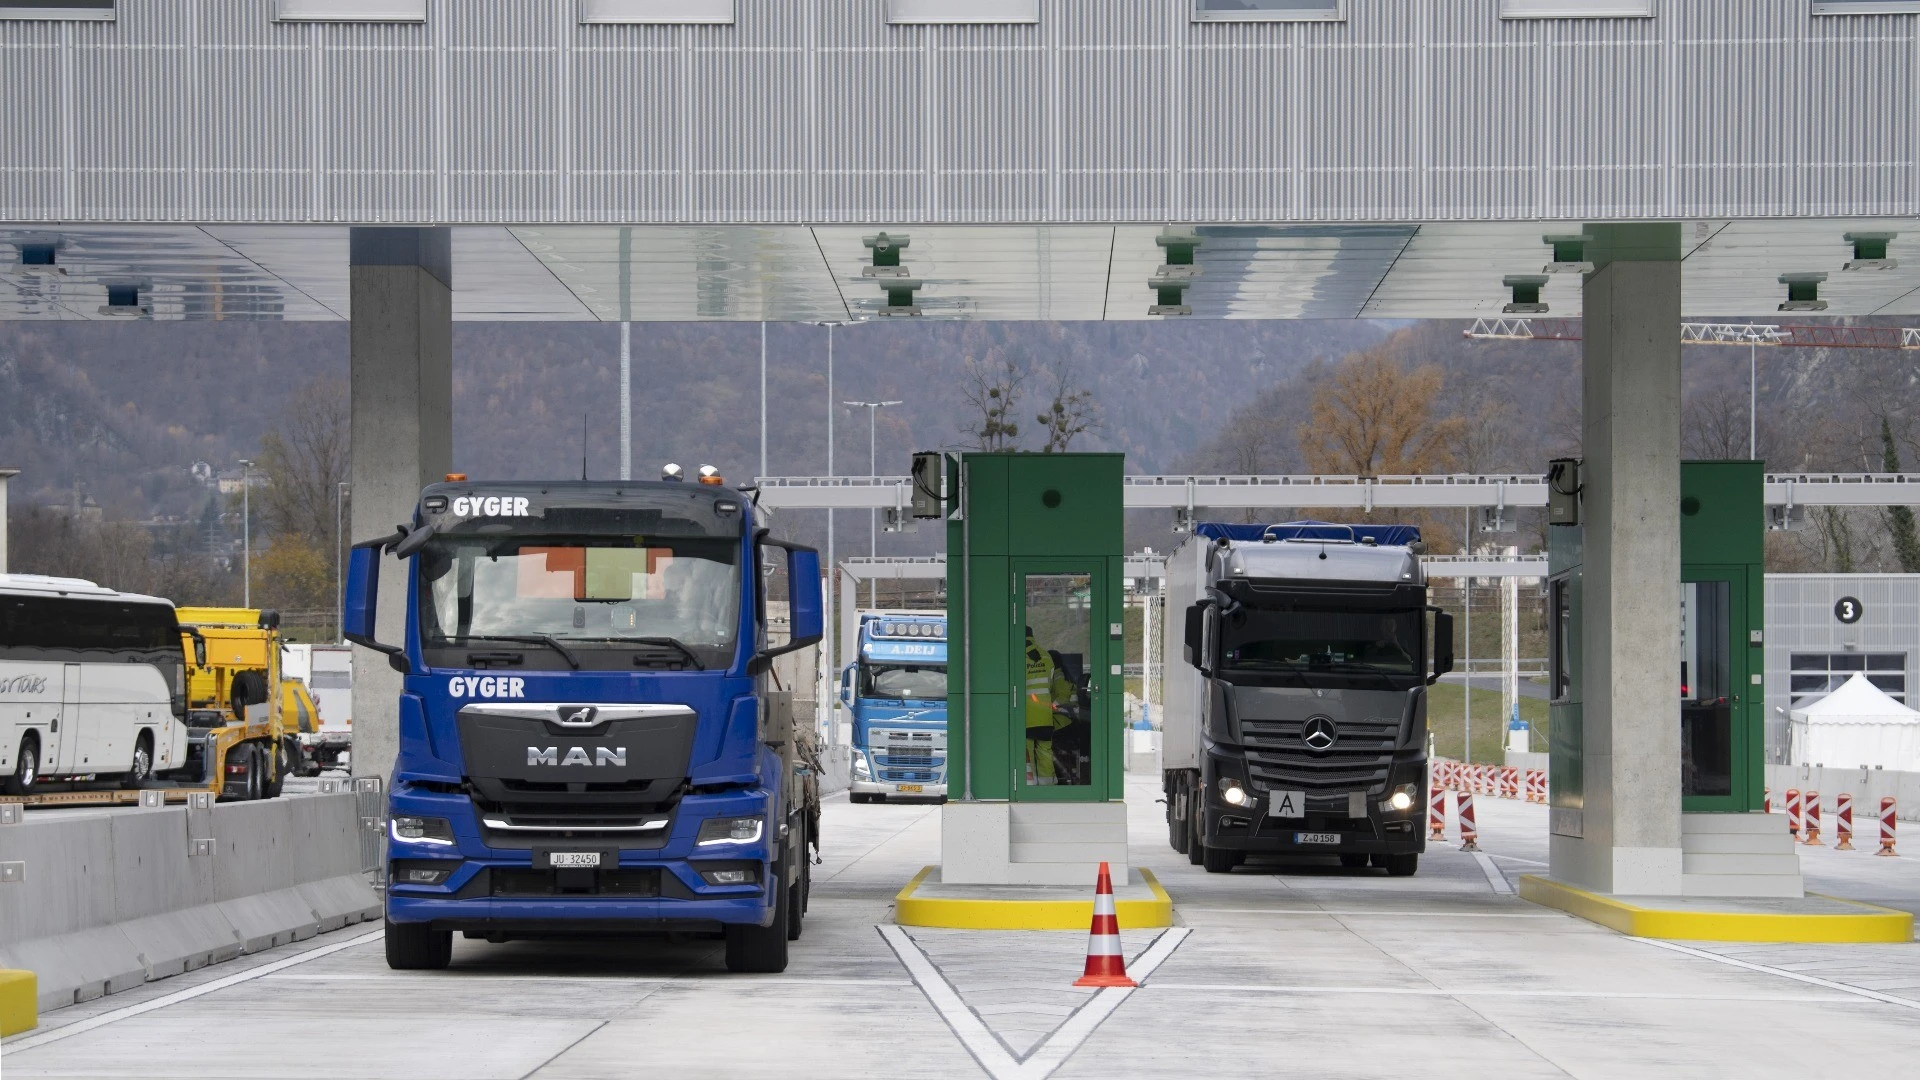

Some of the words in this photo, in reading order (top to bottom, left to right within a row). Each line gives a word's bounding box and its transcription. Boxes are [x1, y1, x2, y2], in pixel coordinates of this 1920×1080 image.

[453, 496, 529, 516] GYGER
[1842, 601, 1854, 619] 3
[449, 677, 525, 697] GYGER
[527, 746, 627, 766] MAN
[1279, 792, 1294, 813] A
